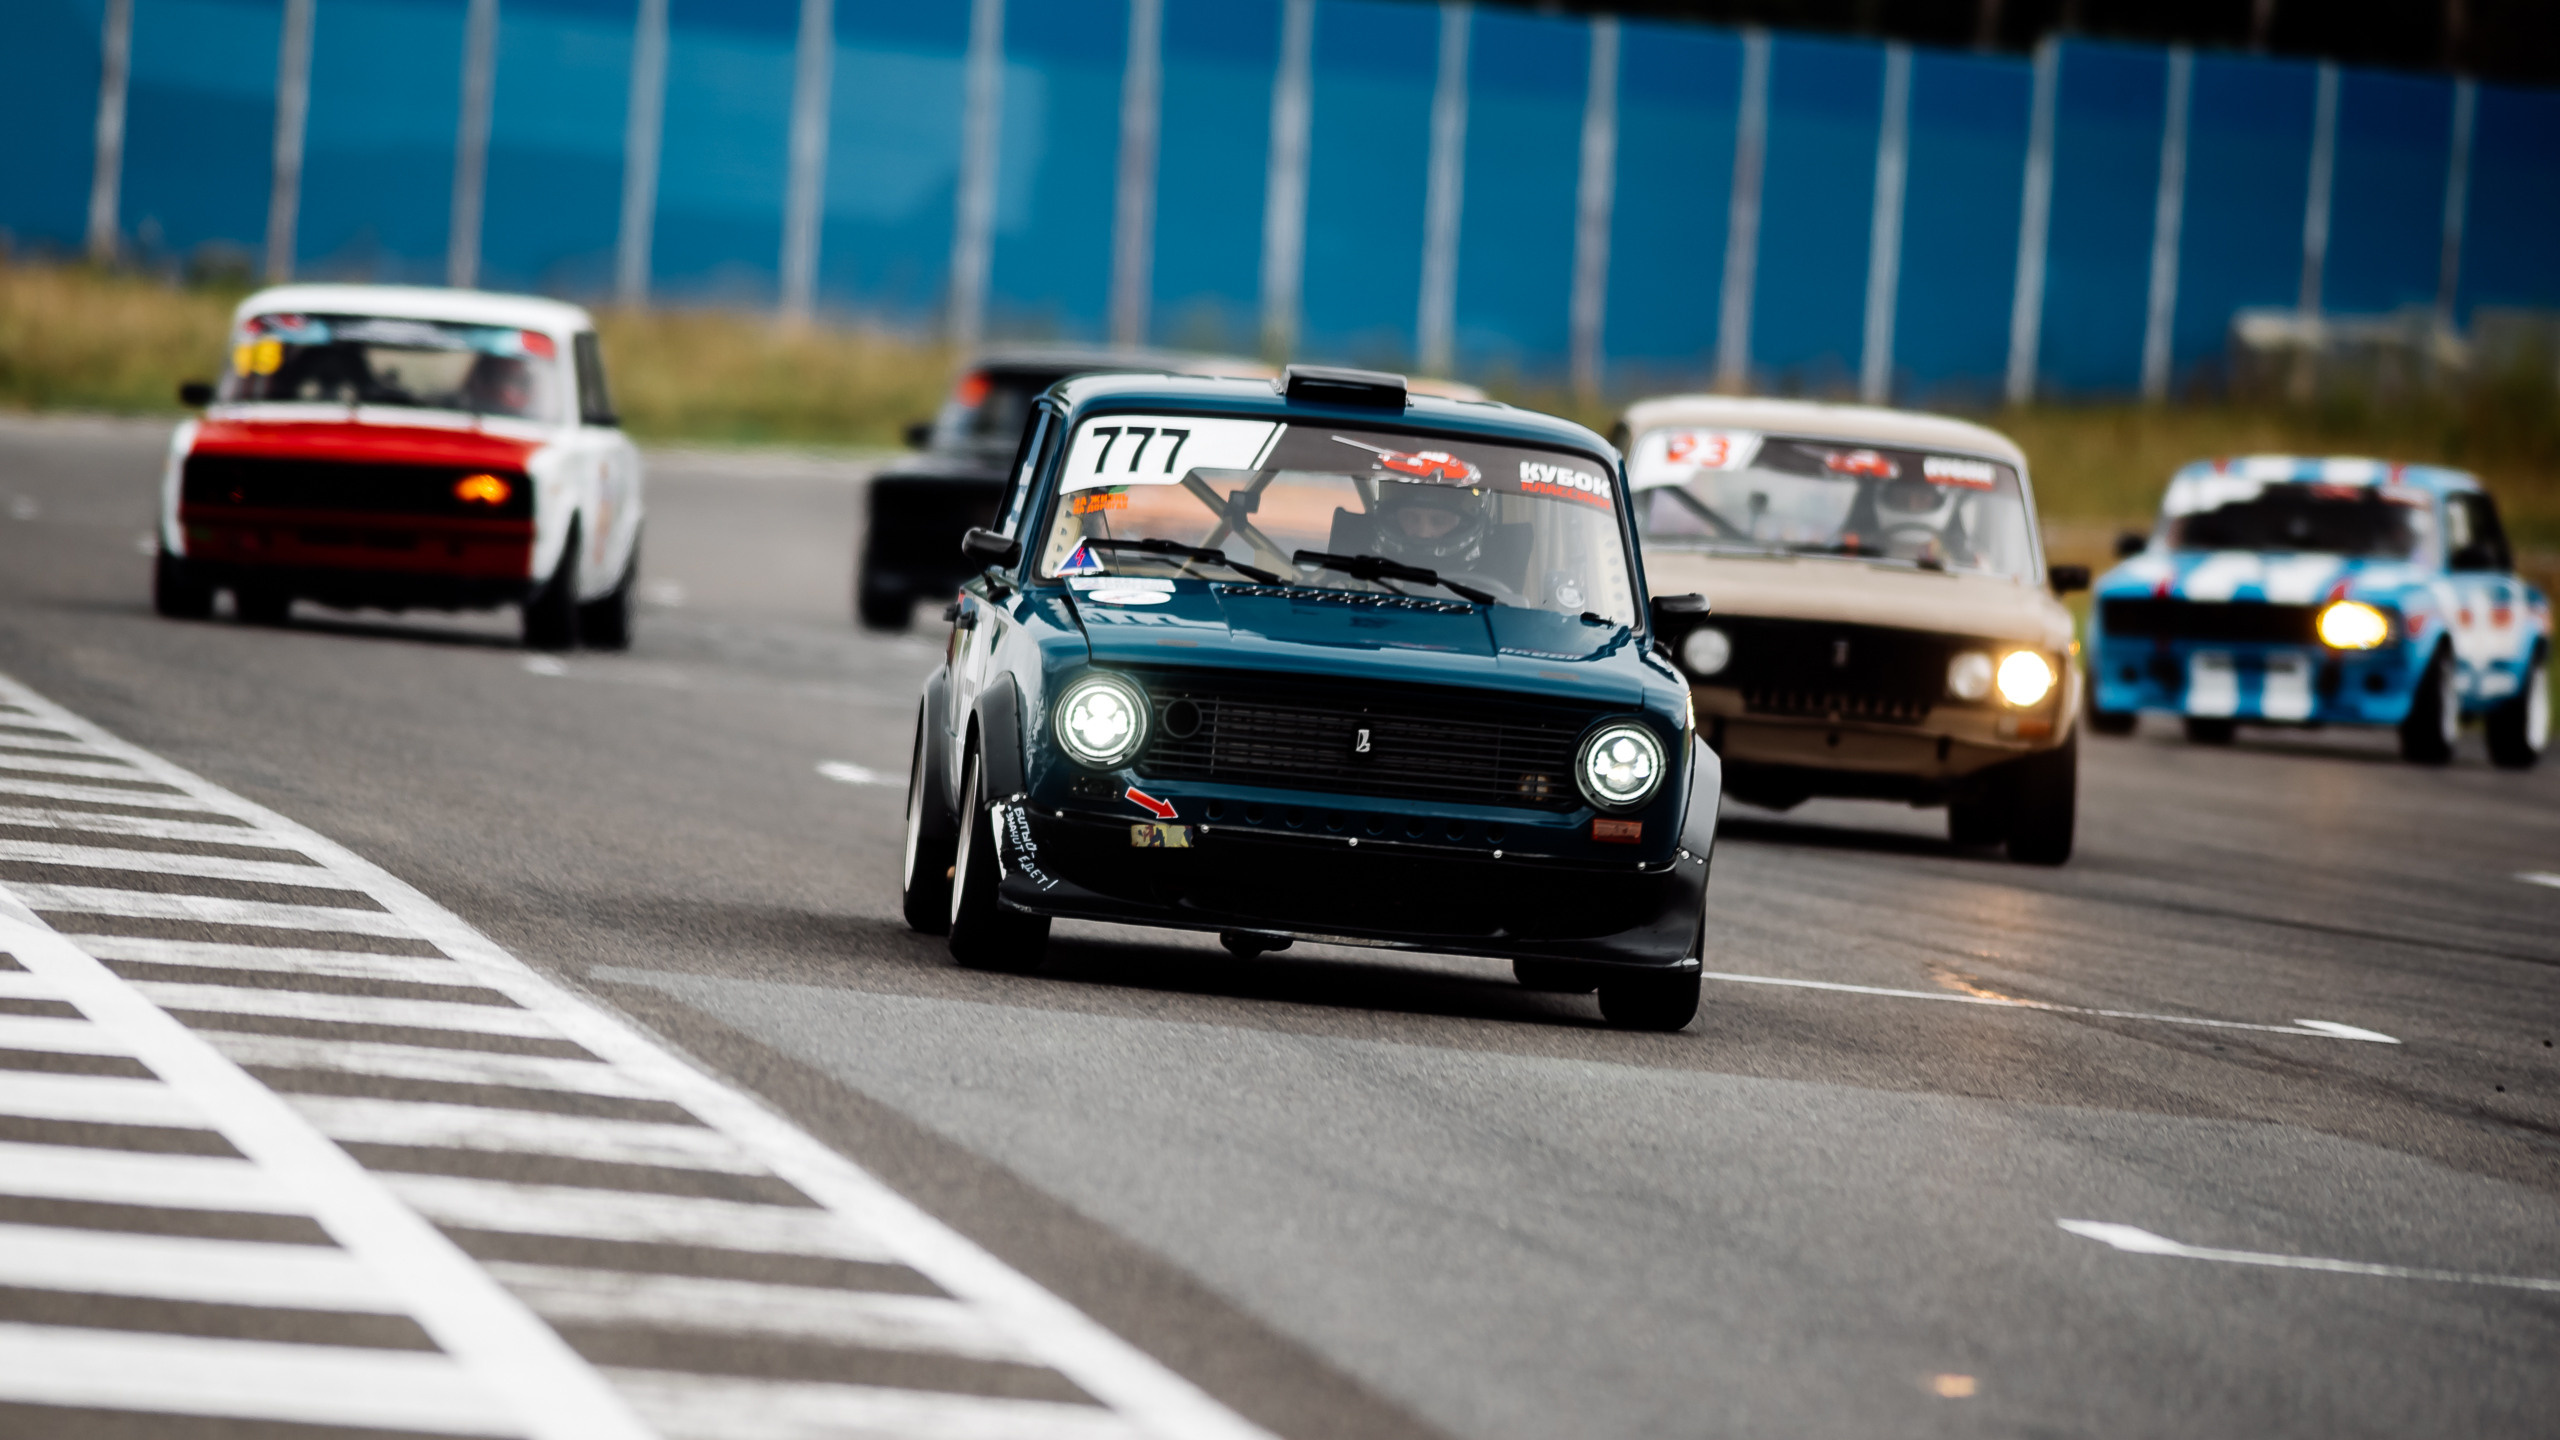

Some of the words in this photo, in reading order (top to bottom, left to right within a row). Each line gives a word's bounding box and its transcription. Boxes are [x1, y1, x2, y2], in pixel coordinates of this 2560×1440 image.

[1092, 425, 1191, 475] 777
[1665, 432, 1730, 468] 23
[1519, 461, 1611, 500] КУБОК
[1520, 480, 1611, 511] КЛАССИКИ
